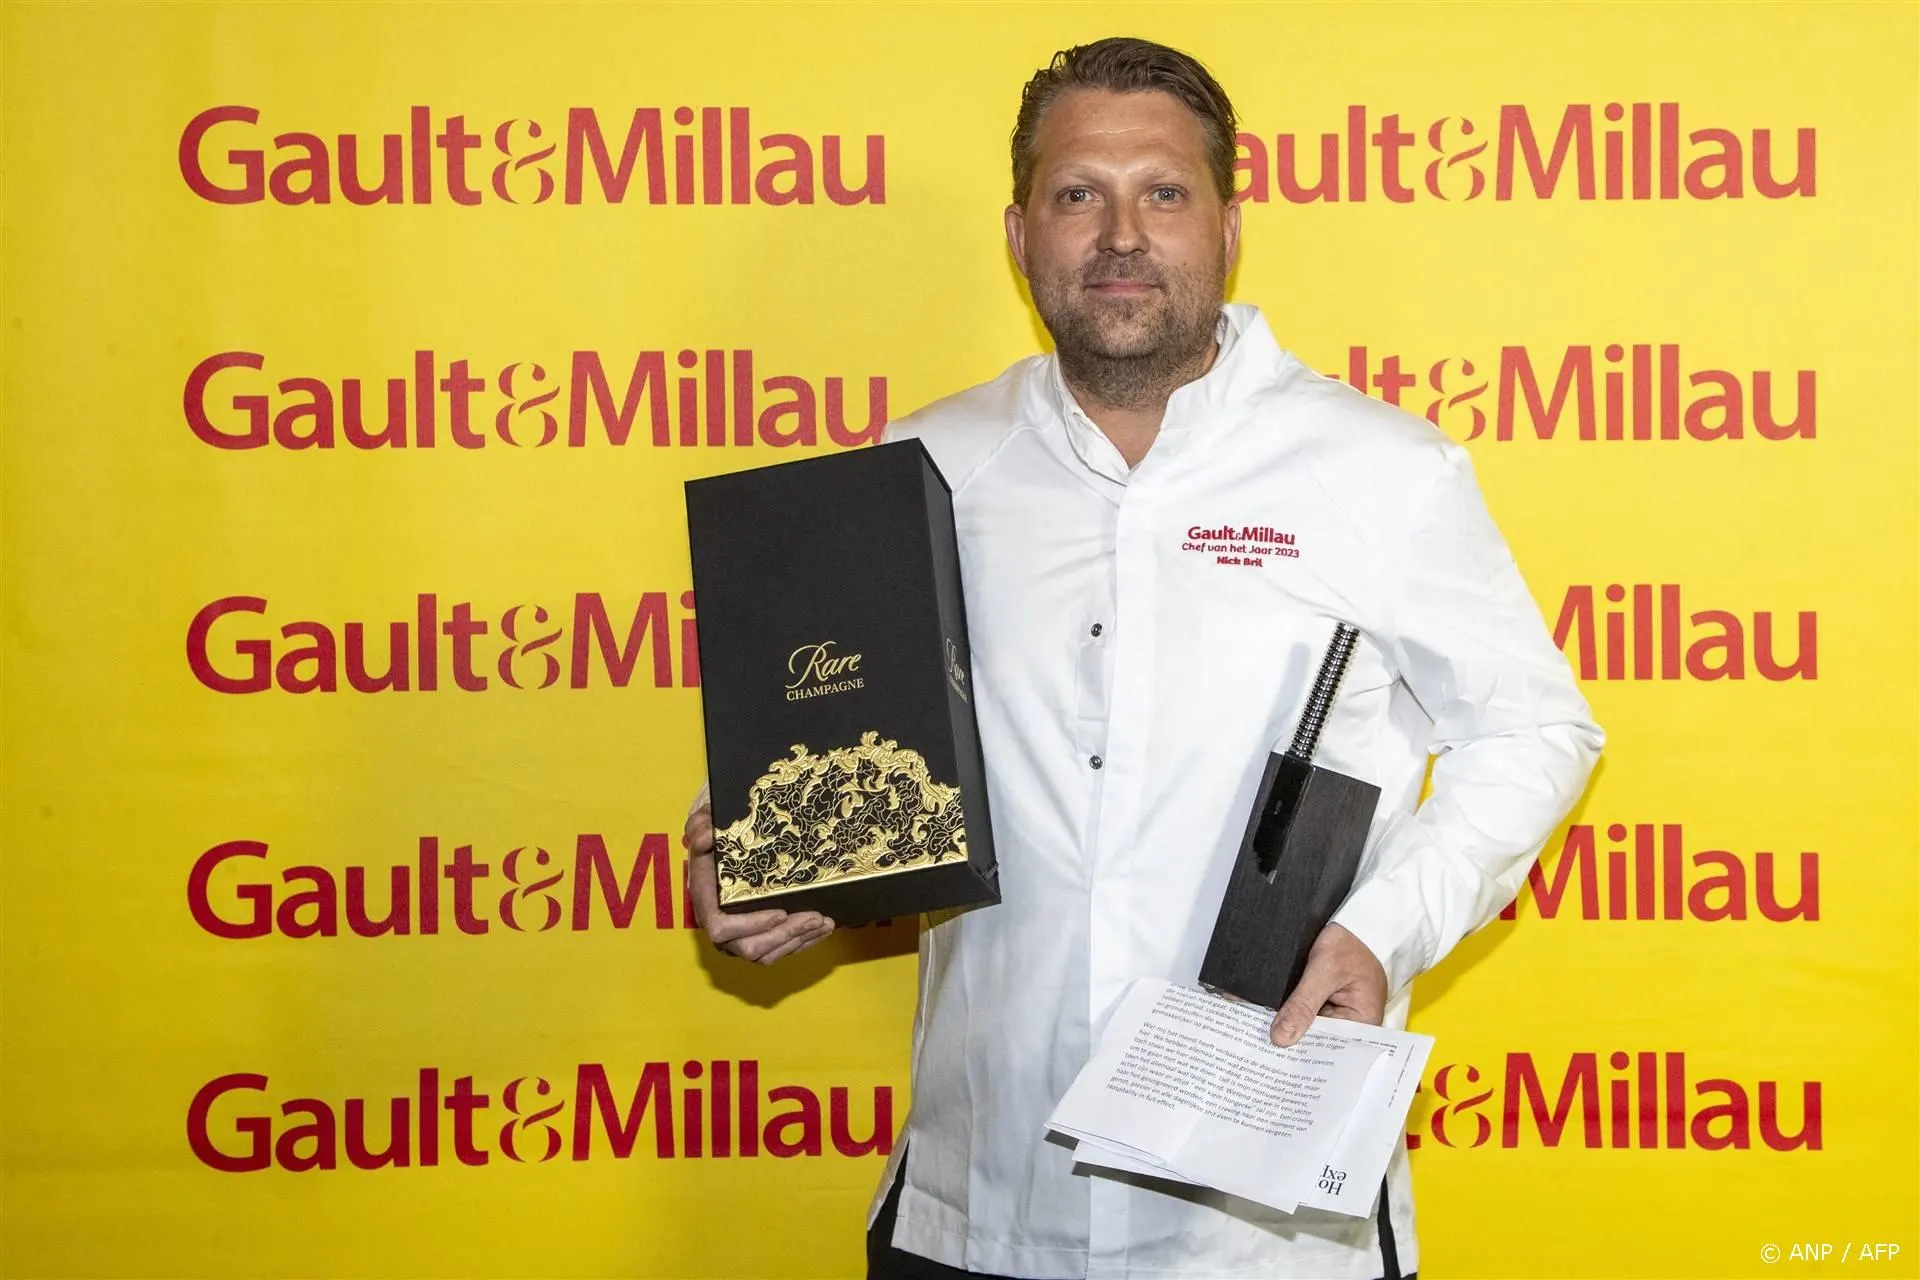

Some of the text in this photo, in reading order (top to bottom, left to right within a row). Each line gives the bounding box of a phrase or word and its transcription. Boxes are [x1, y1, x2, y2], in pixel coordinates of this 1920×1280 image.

[178, 105, 886, 206] Gault&Millau
[1233, 103, 1816, 204] ault&Millau
[183, 349, 888, 451] Gault&Millau
[1182, 542, 1300, 558] Chef van het Jaar 2023
[1187, 525, 1296, 546] Gault&Millau
[1217, 556, 1241, 566] Nick
[785, 640, 862, 689] Rare
[786, 677, 864, 701] CHAMPAGNE
[186, 1059, 894, 1174] Gault&Millau
